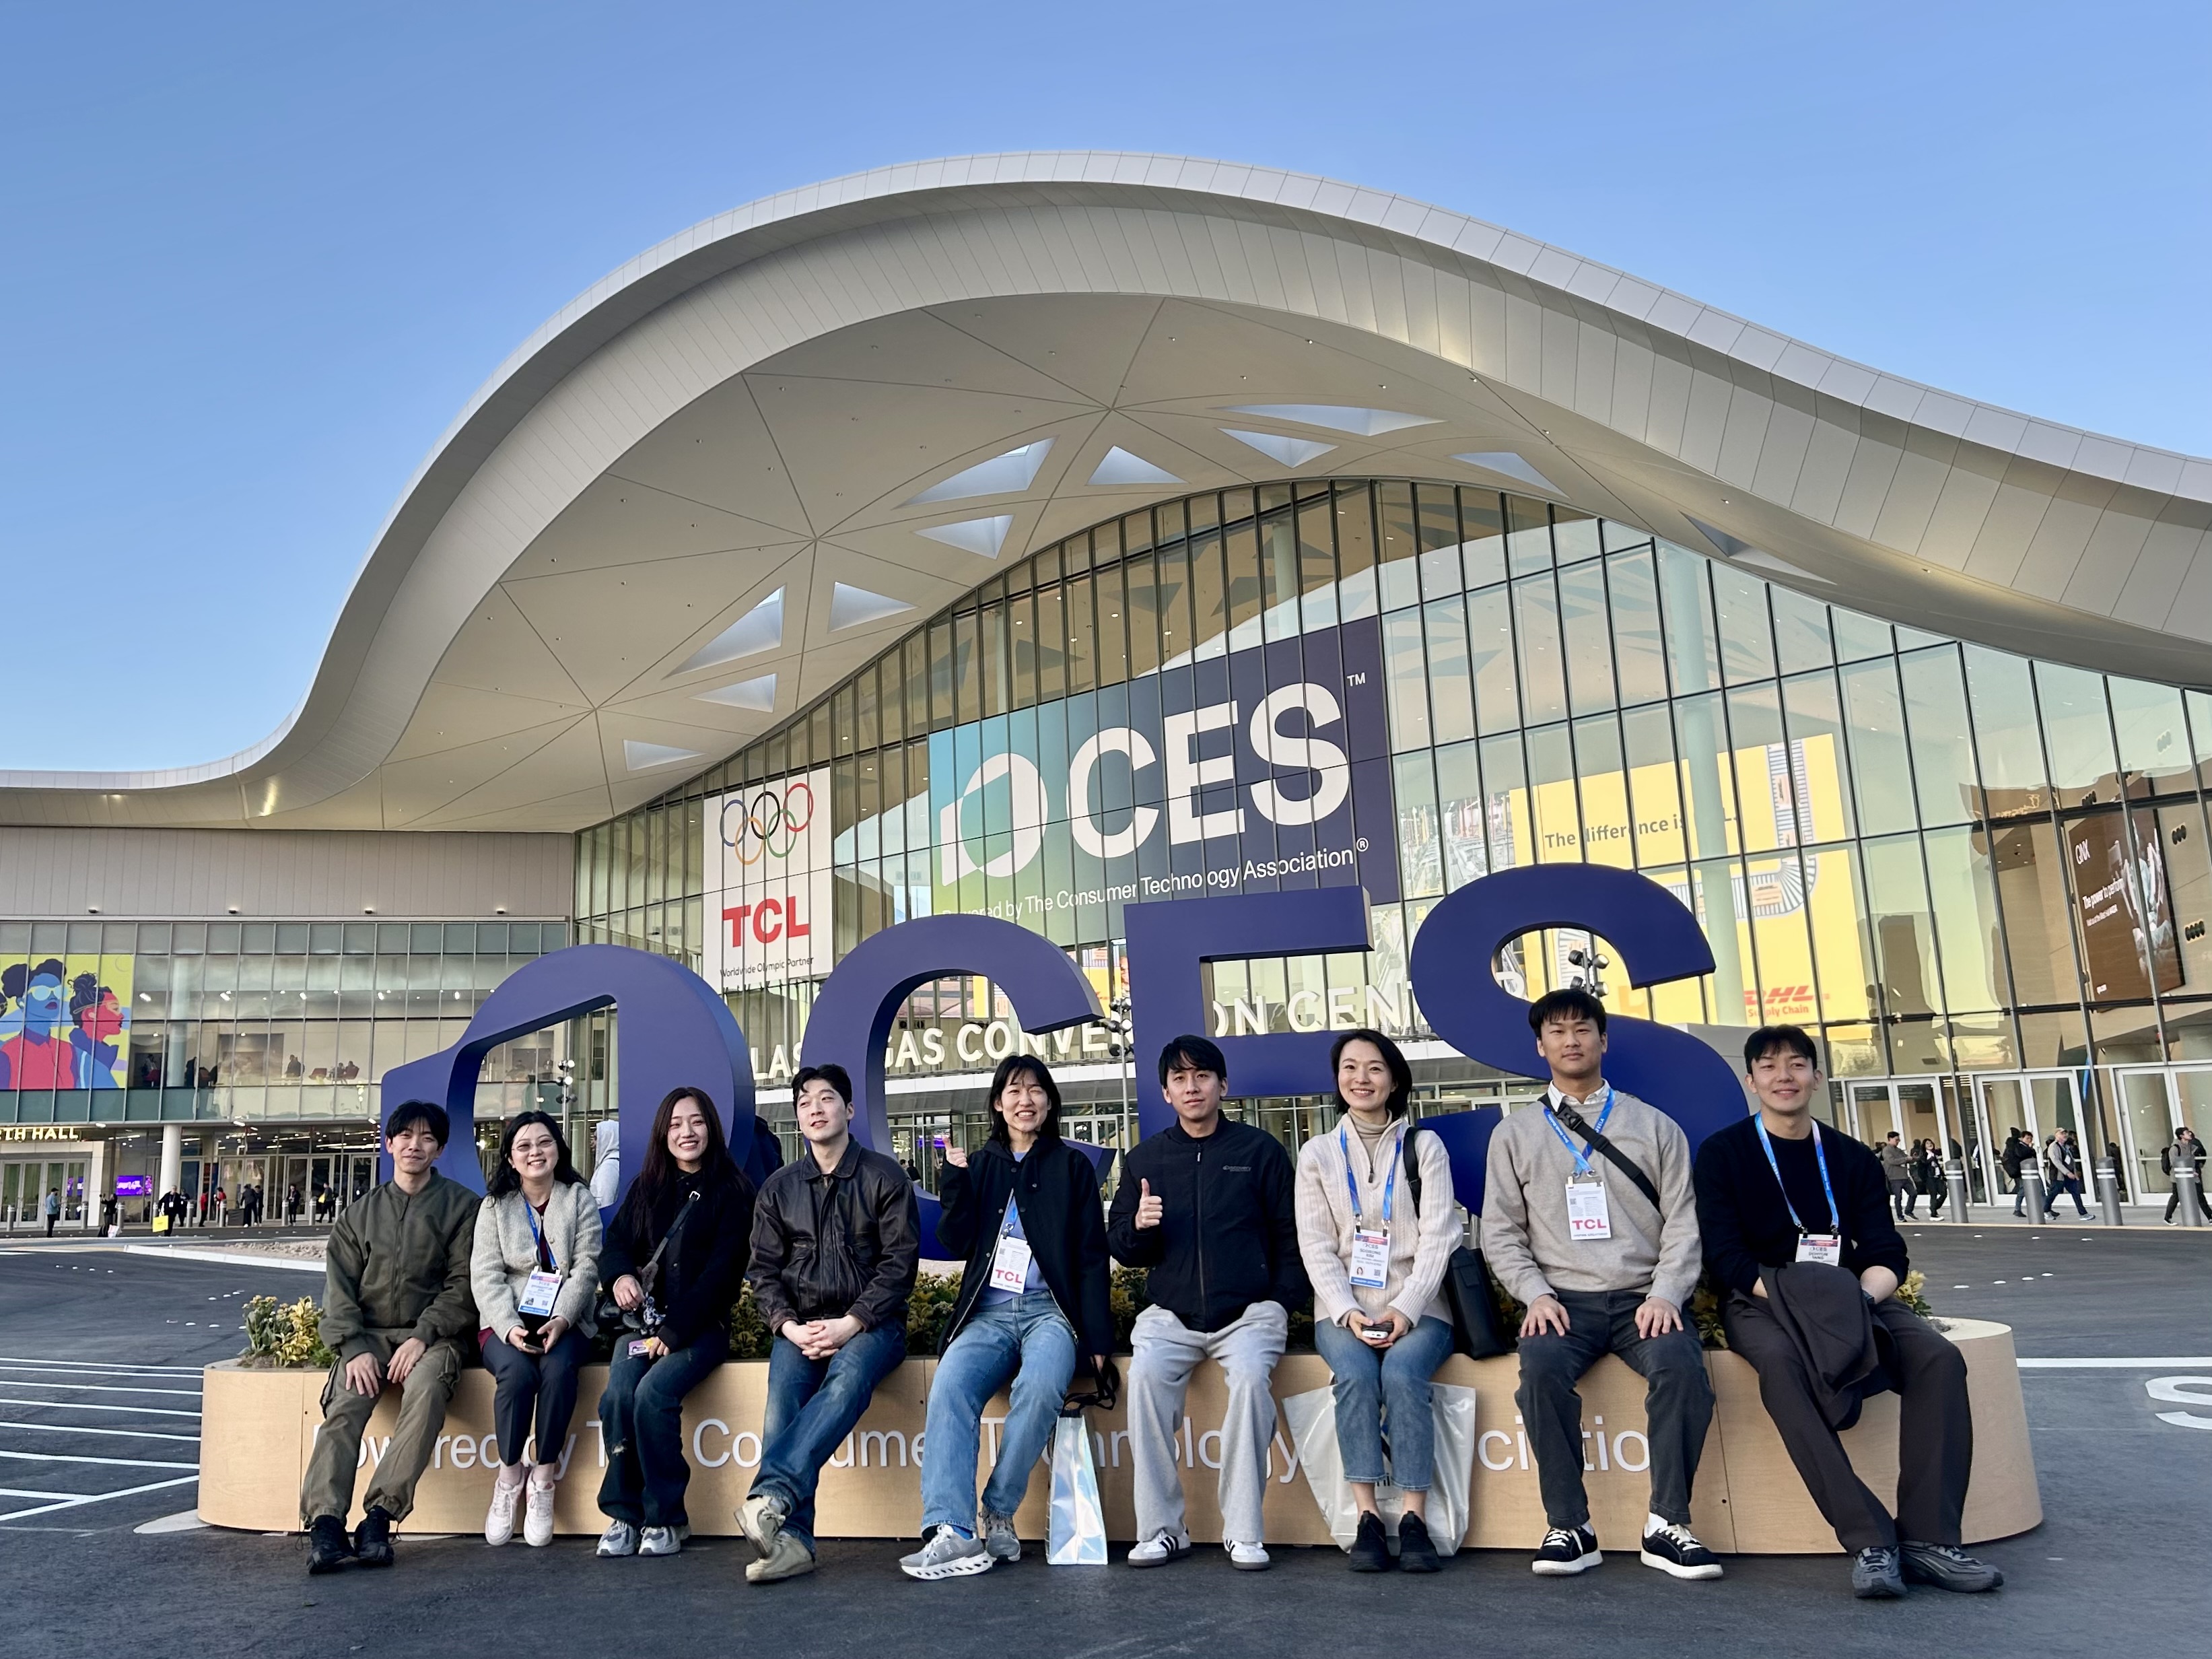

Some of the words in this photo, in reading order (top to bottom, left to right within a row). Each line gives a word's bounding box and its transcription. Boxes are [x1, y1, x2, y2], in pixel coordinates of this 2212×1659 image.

[1066, 682, 1349, 858] CES
[1545, 832, 1576, 848] The
[1583, 819, 1669, 842] iffernce
[2075, 838, 2090, 865] QNX
[942, 901, 1002, 919] ered
[1006, 900, 1023, 920] by
[1025, 895, 1053, 914] The
[1057, 883, 1137, 909] Consumer
[1140, 866, 1239, 895] Technoogy
[722, 895, 810, 948] TCL
[757, 959, 786, 972] Olympic
[787, 957, 815, 968] Partner
[1744, 985, 1814, 1006] DHL
[1748, 1007, 1781, 1017] Sply
[1783, 1004, 1809, 1015] Chain
[0, 1127, 26, 1141] TH
[32, 1127, 79, 1141] HALL
[1572, 1219, 1607, 1230] TCL
[995, 1269, 1023, 1284] TCL
